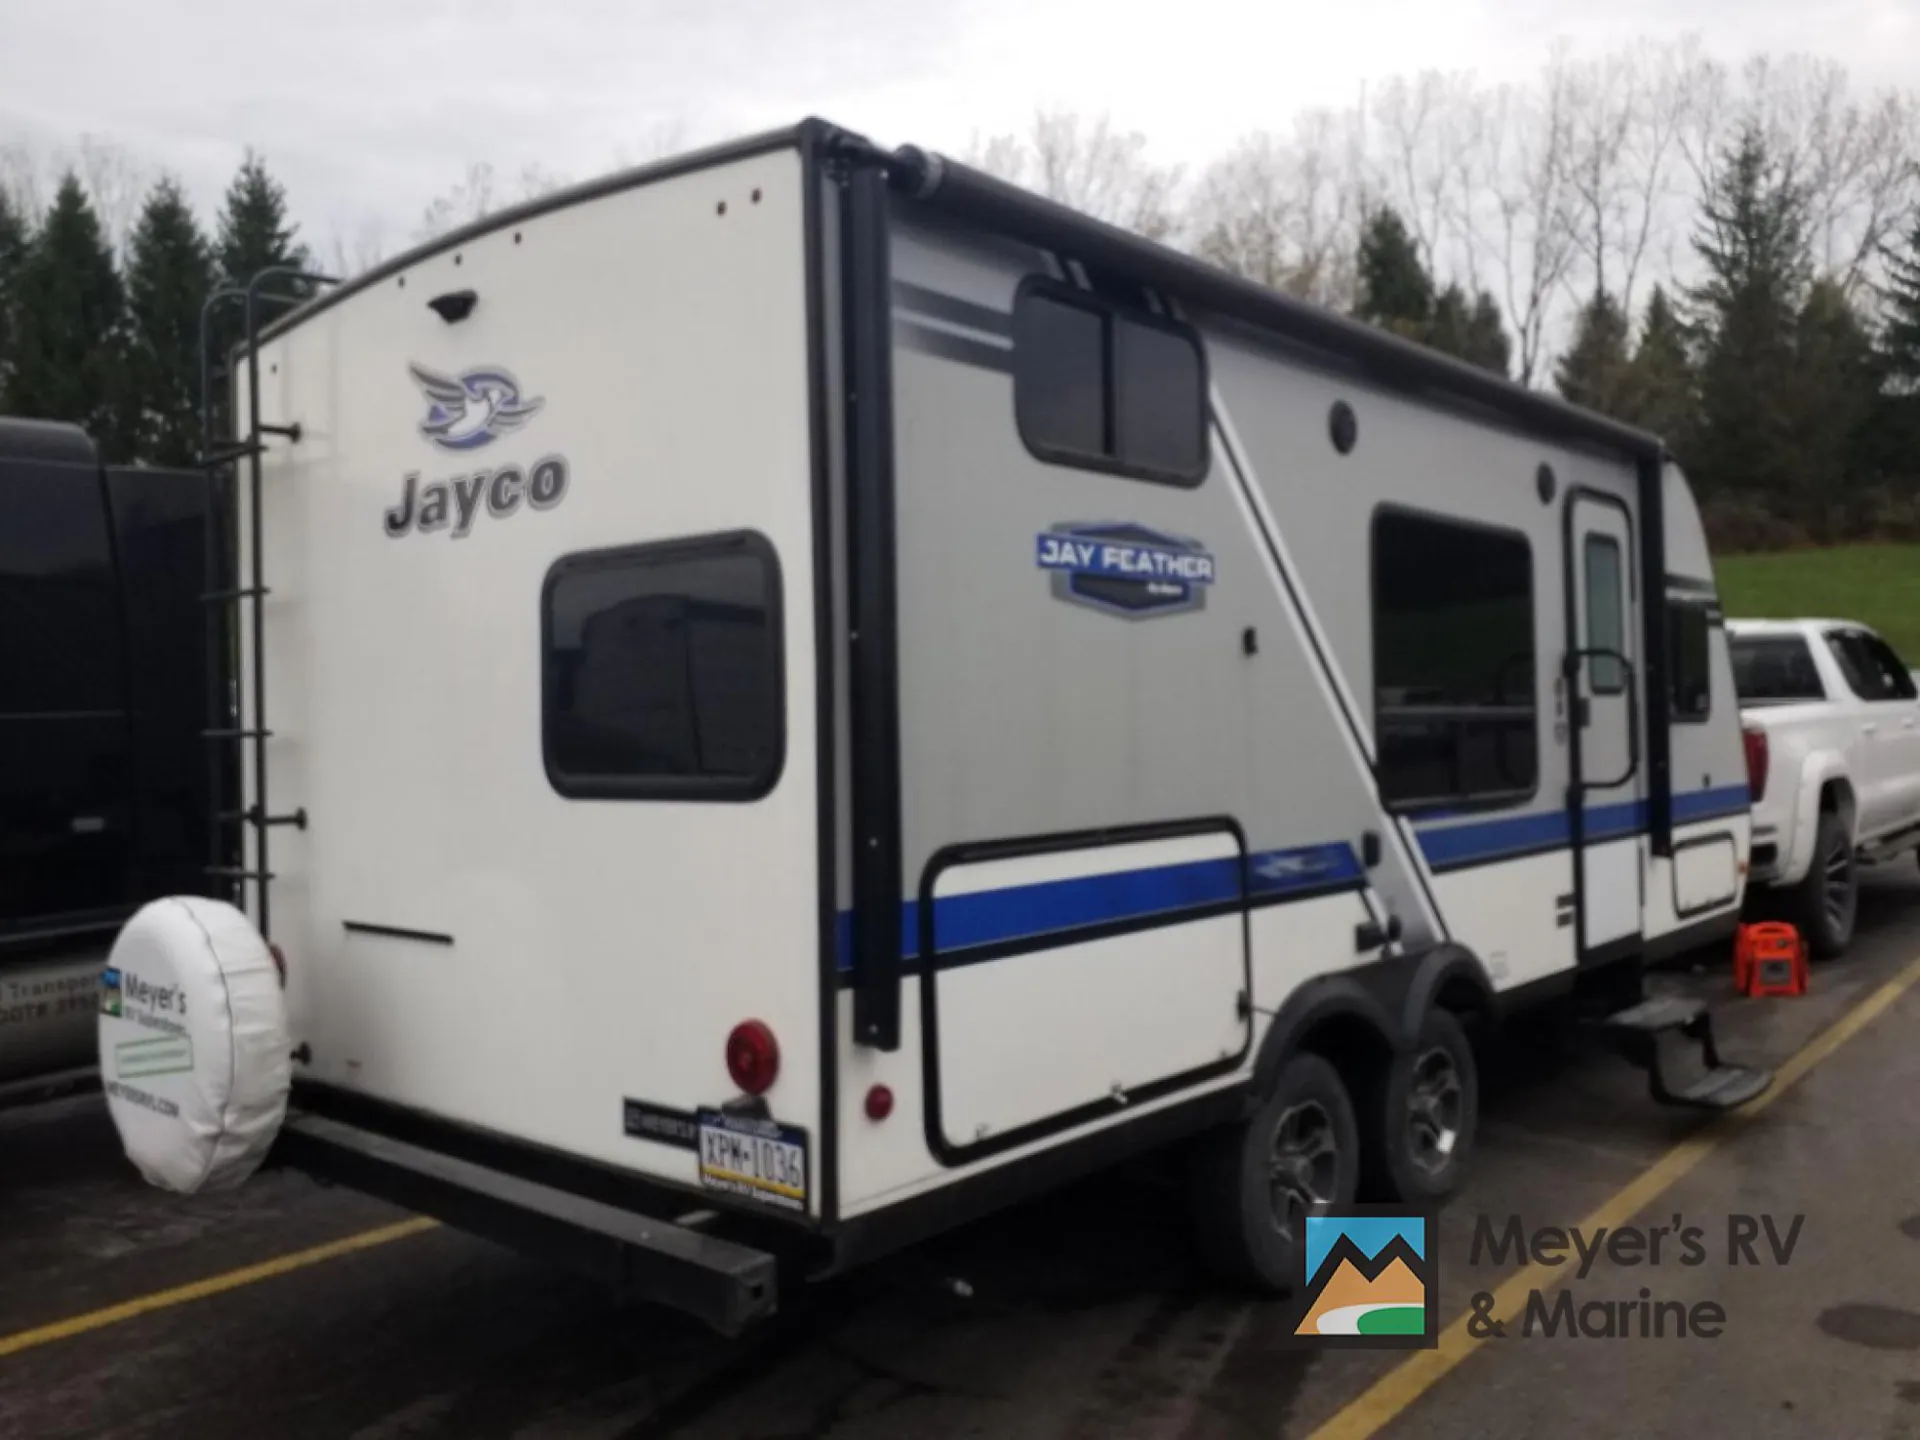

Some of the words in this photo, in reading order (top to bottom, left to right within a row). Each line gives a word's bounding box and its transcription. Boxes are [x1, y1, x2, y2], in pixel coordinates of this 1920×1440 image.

[385, 455, 569, 539] Jayco
[1041, 540, 1094, 568] JAY
[1102, 547, 1212, 577] FEATHER
[124, 972, 187, 1015] Meyer's
